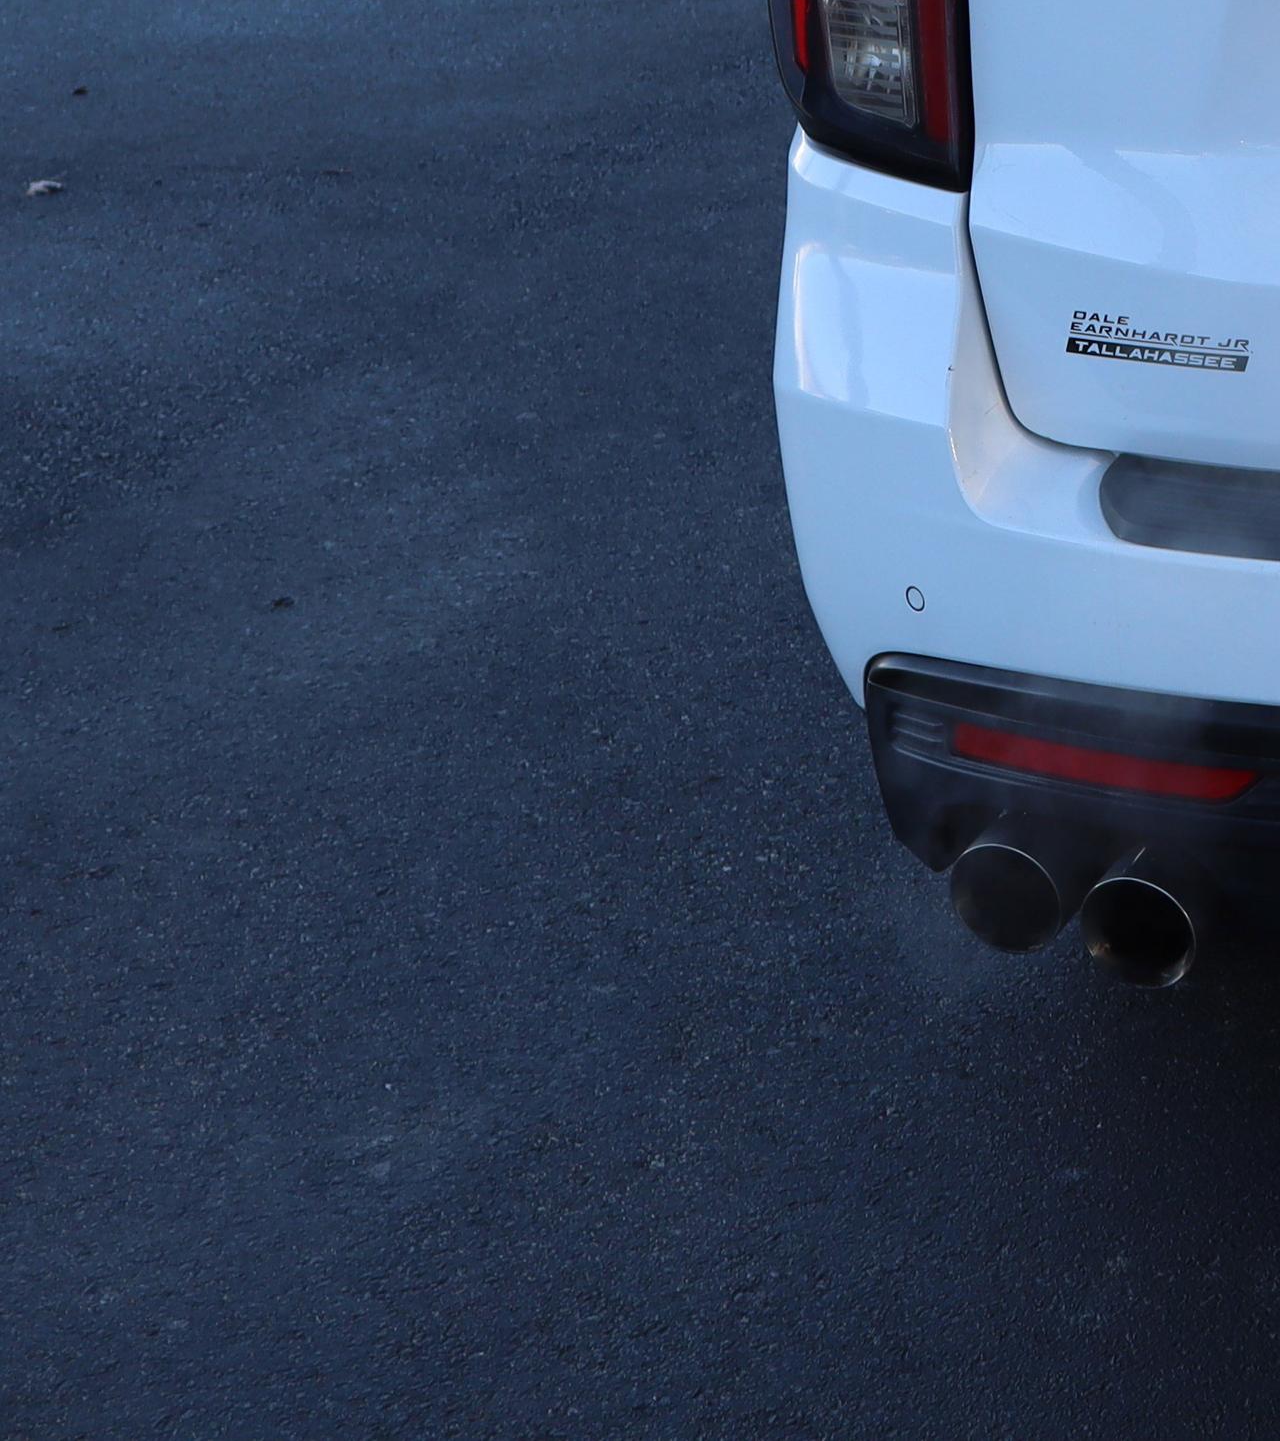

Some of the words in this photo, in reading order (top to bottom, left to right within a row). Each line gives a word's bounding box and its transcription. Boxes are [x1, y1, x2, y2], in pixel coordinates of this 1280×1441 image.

[1073, 310, 1129, 325] DALE
[1070, 321, 1211, 346] EARNHARDT
[1074, 340, 1238, 369] TALLAHASSEE
